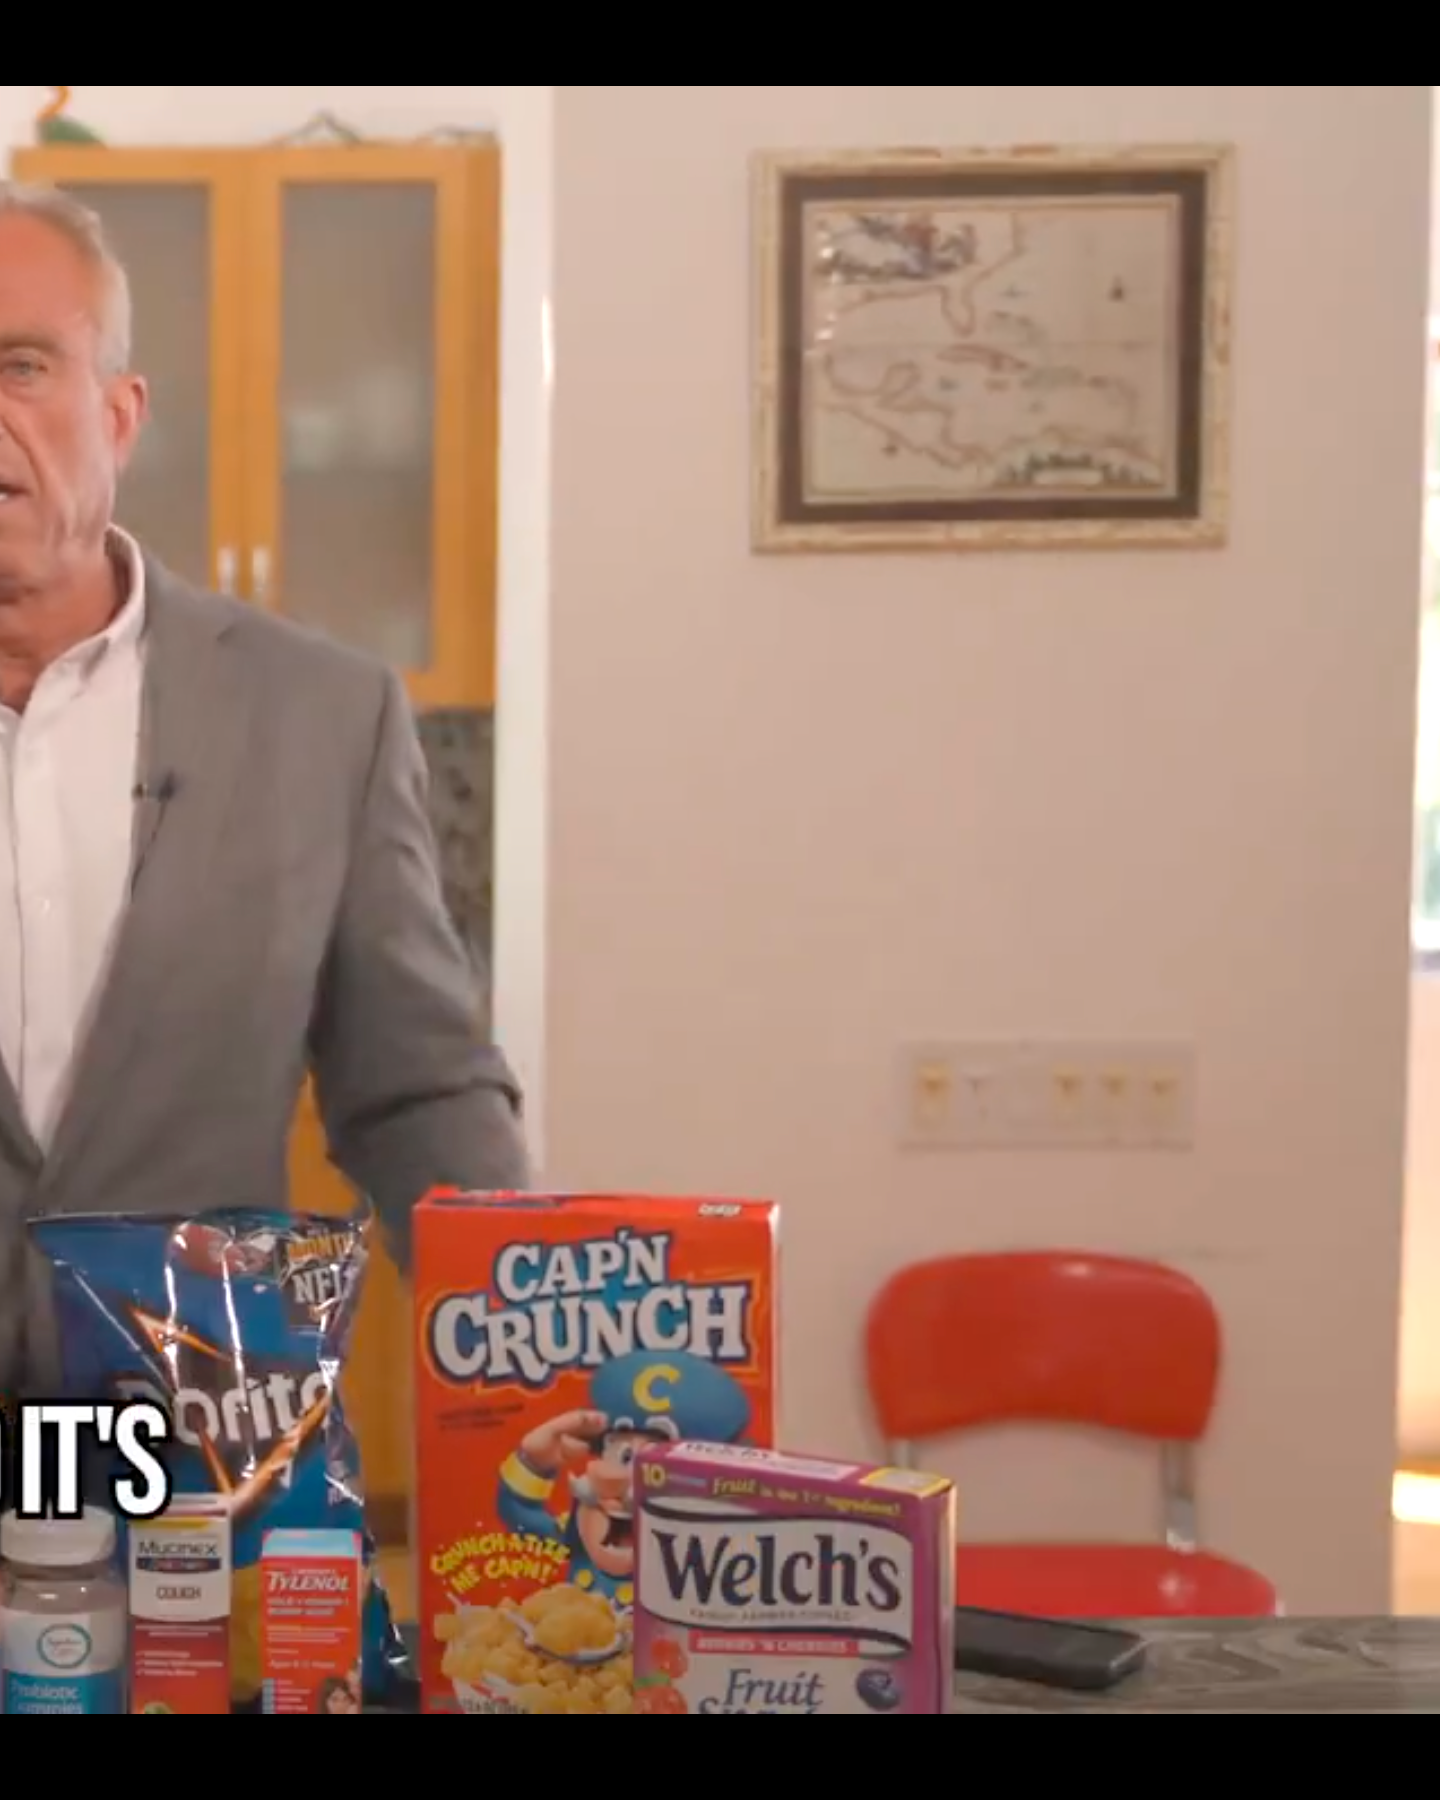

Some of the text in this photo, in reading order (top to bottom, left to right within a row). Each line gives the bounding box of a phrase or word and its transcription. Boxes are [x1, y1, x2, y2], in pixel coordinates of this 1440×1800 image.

[498, 1230, 669, 1302] CAP'N
[434, 1284, 747, 1381] CRUNCH
[633, 1364, 680, 1412] C
[641, 1463, 666, 1487] 10
[266, 1571, 350, 1592] TYLENOL
[651, 1527, 901, 1612] Welch's
[723, 1668, 826, 1707] Fruit
